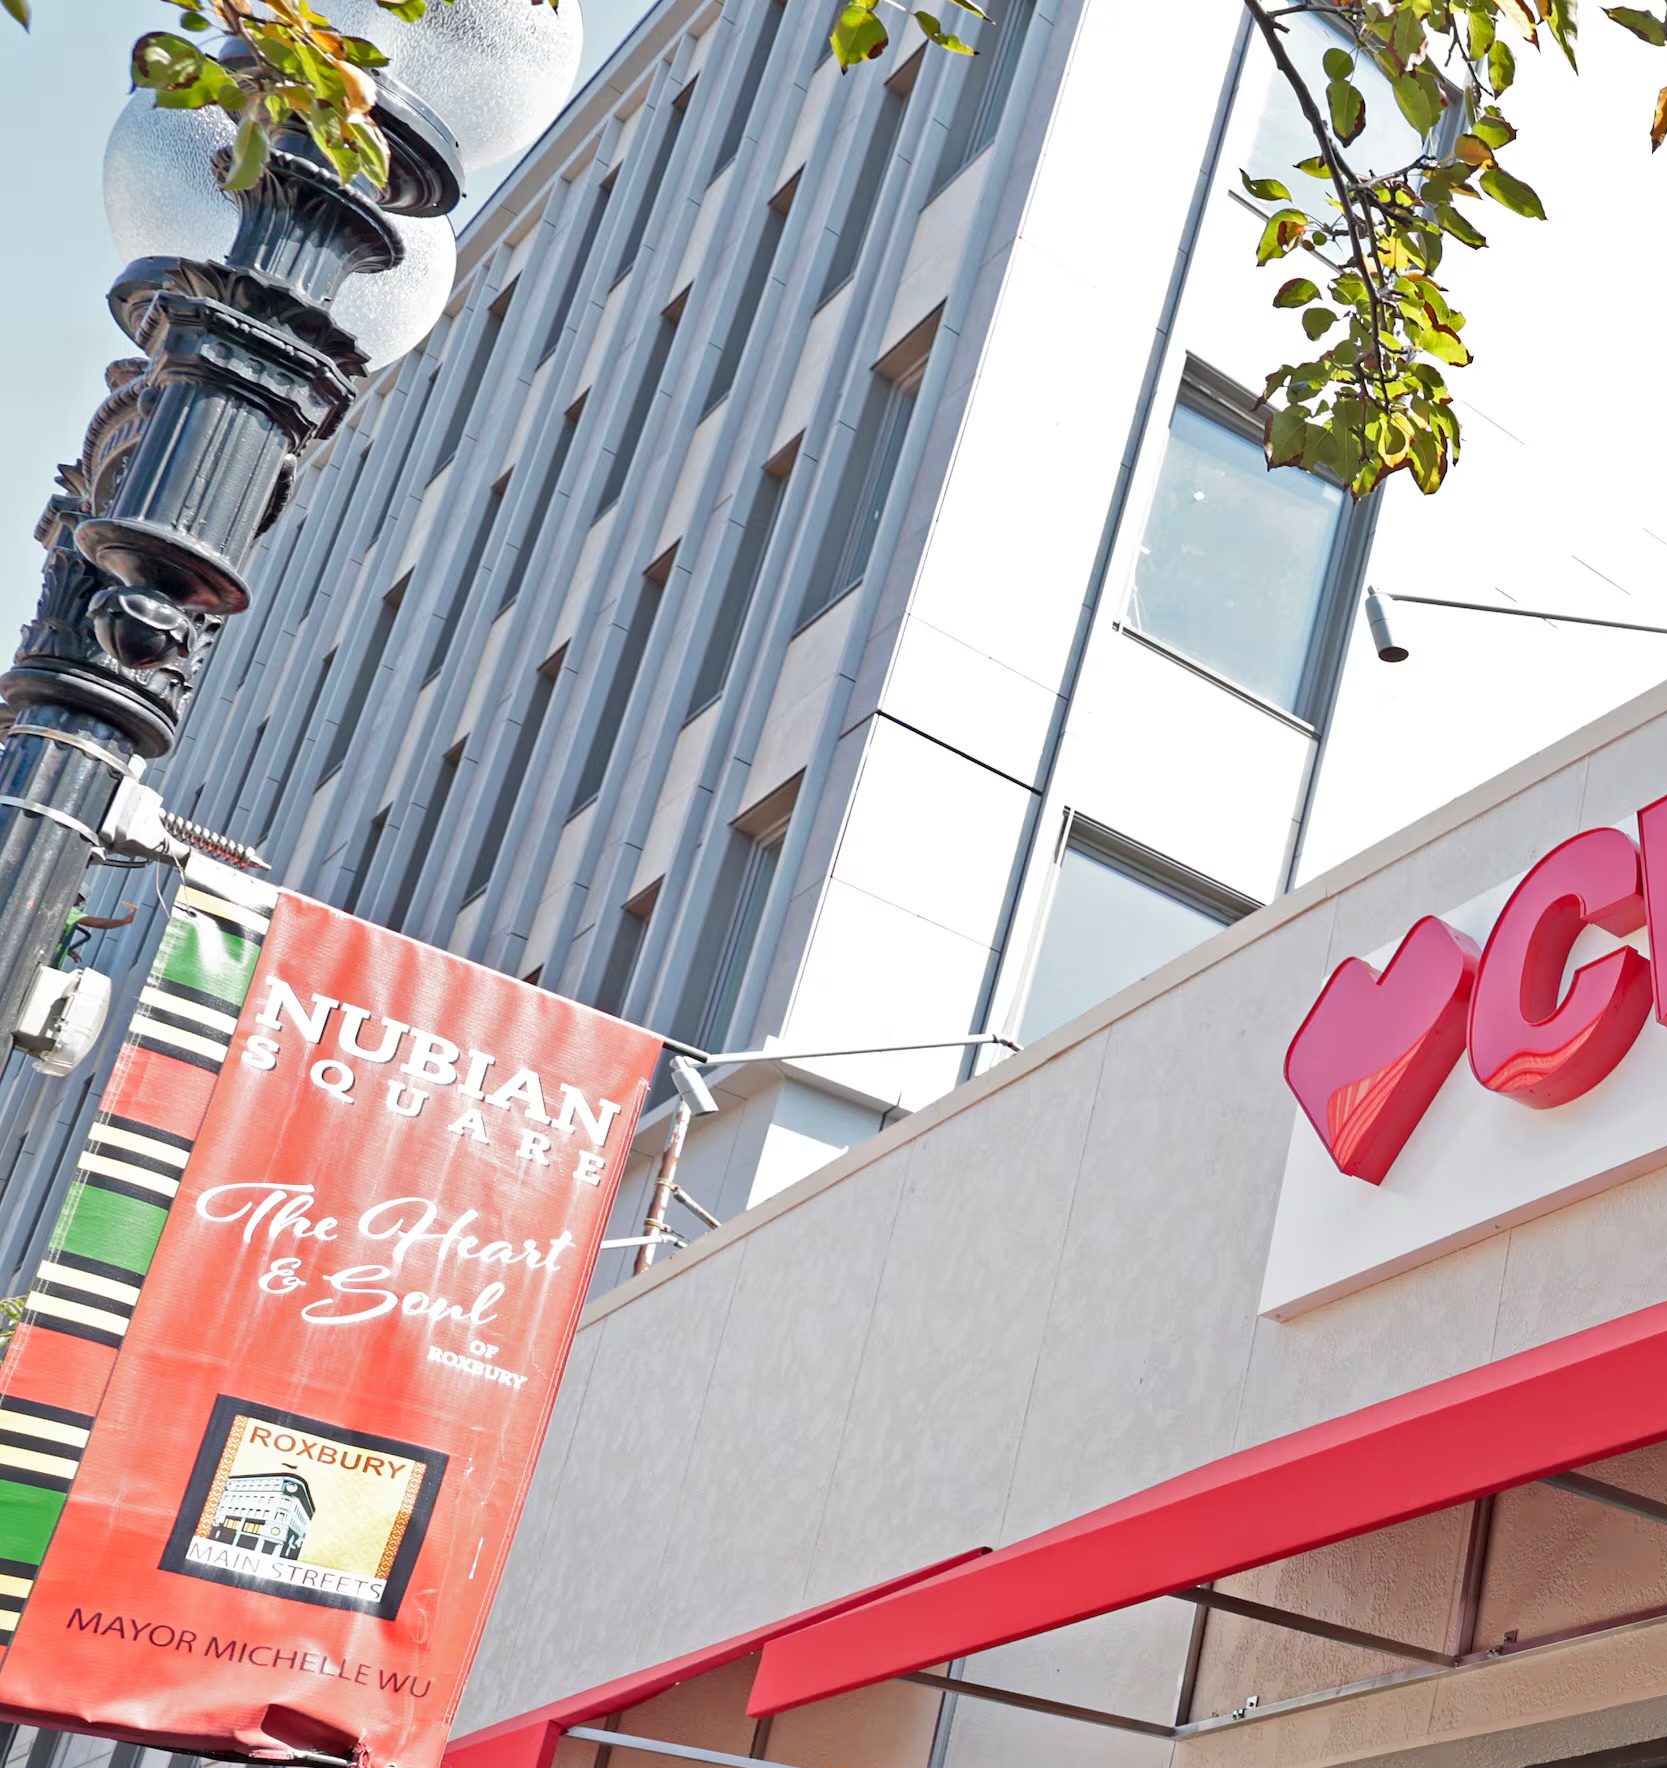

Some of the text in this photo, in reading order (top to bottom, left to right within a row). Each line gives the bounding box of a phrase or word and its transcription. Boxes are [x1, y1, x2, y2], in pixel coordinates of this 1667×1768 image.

[255, 975, 622, 1147] NUBIAN
[241, 1034, 606, 1187] SQUARE
[196, 1182, 577, 1272] The Heart
[258, 1257, 506, 1325] & Soul
[427, 1346, 529, 1390] ROXBURY
[469, 1339, 500, 1359] OF
[249, 1426, 408, 1480] ROXBURY
[189, 1542, 384, 1601] MAIN STREETS
[66, 1607, 433, 1699] MAYOR MICHELLE WU
